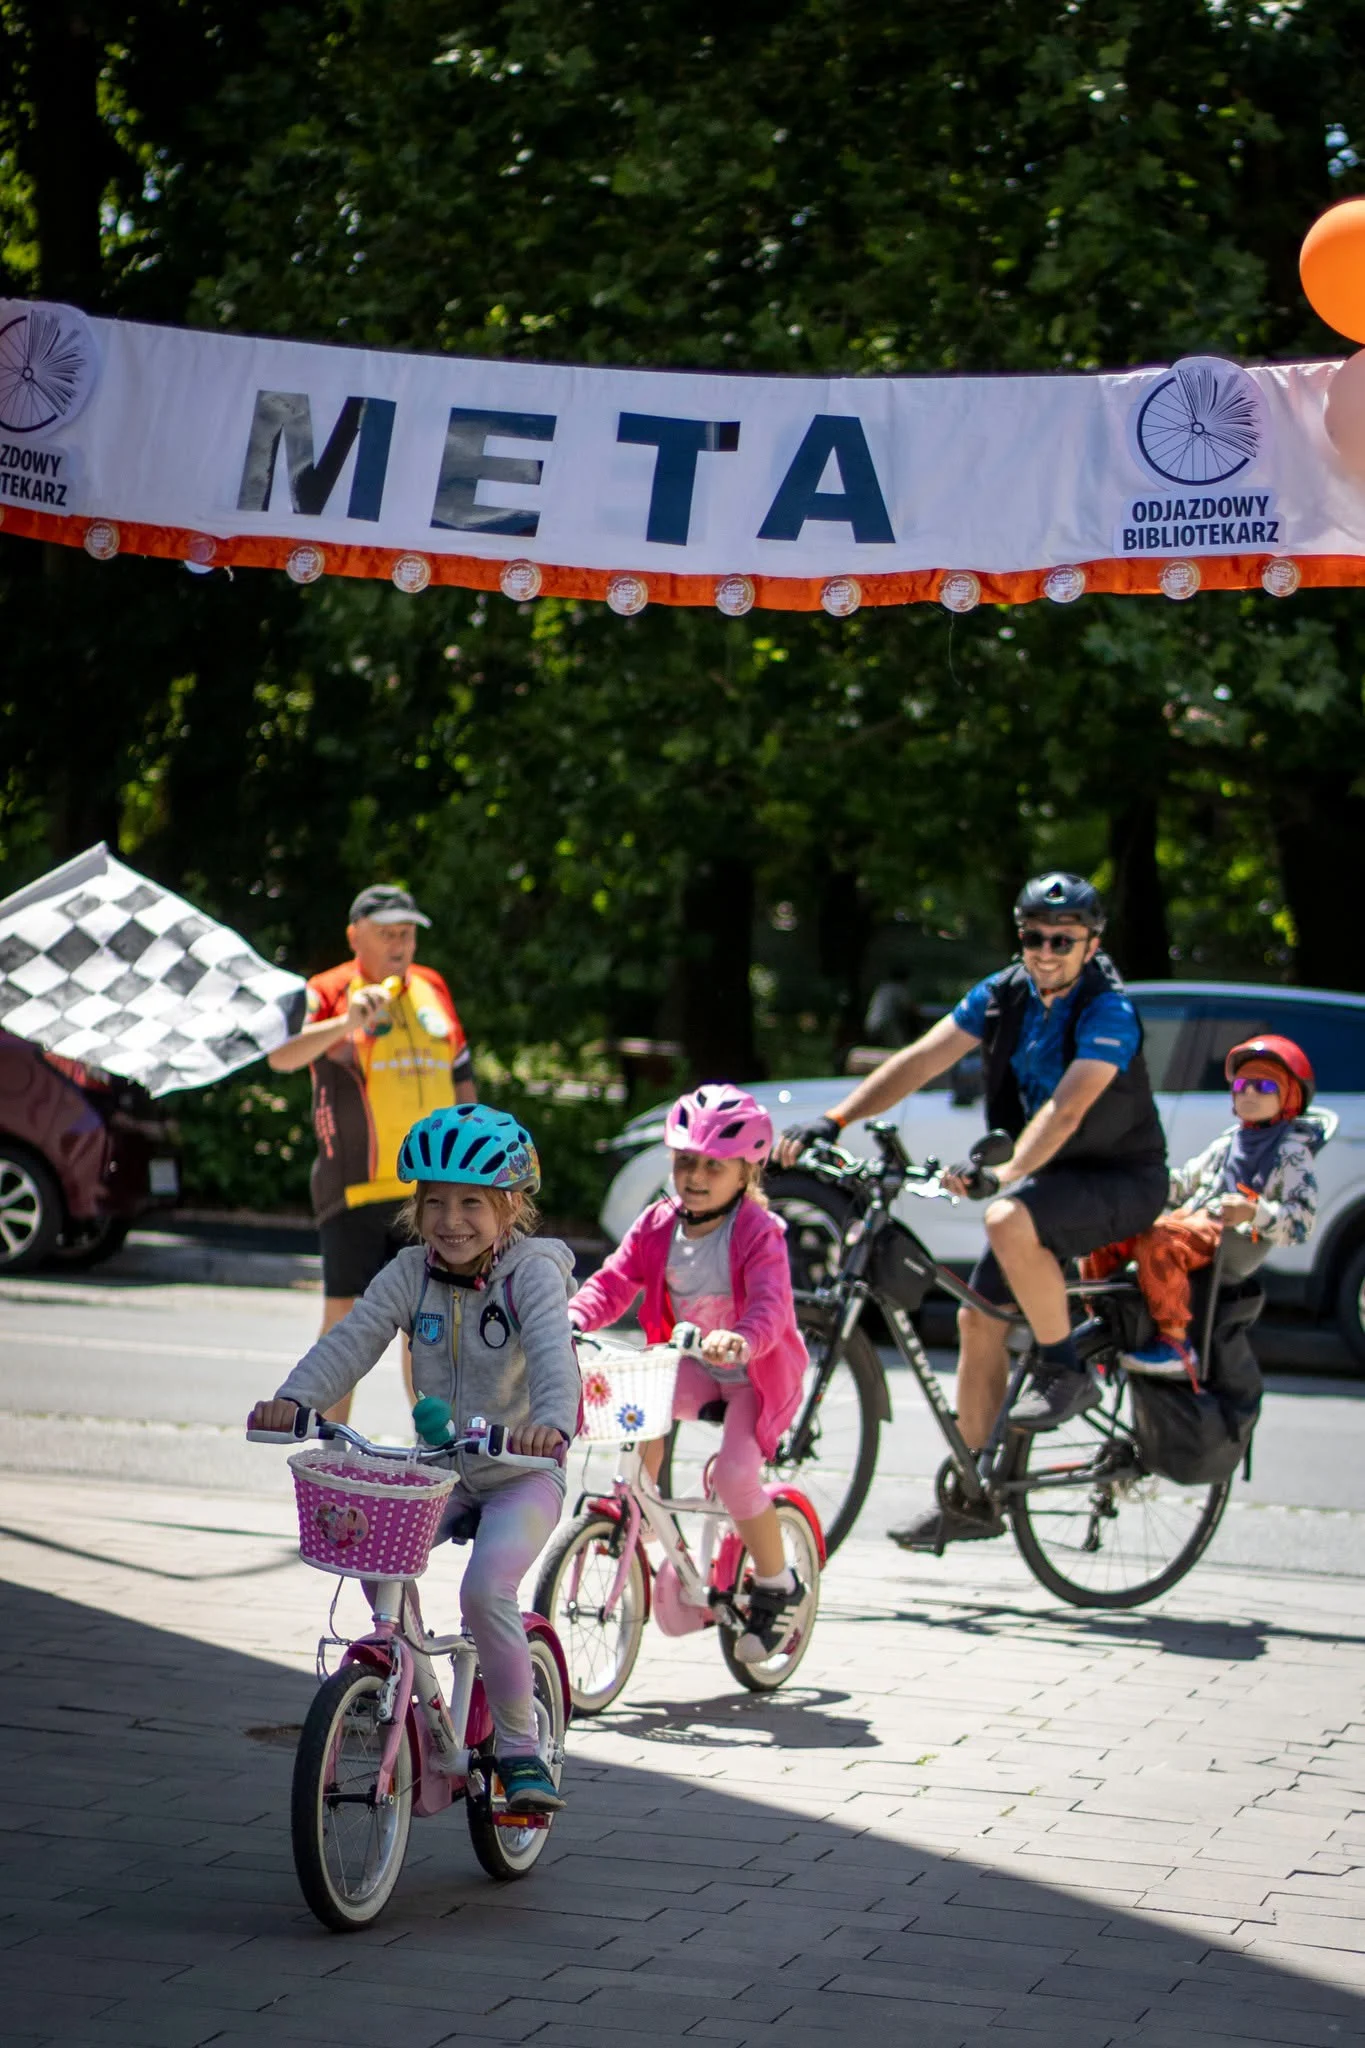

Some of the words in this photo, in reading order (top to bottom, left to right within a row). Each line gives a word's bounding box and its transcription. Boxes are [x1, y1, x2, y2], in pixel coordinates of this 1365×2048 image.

[237, 389, 896, 546] META
[0, 472, 68, 507] TEKARZ
[1132, 495, 1270, 523] ODJAZDOWY
[1122, 521, 1280, 551] BIBLIOTEKARZ
